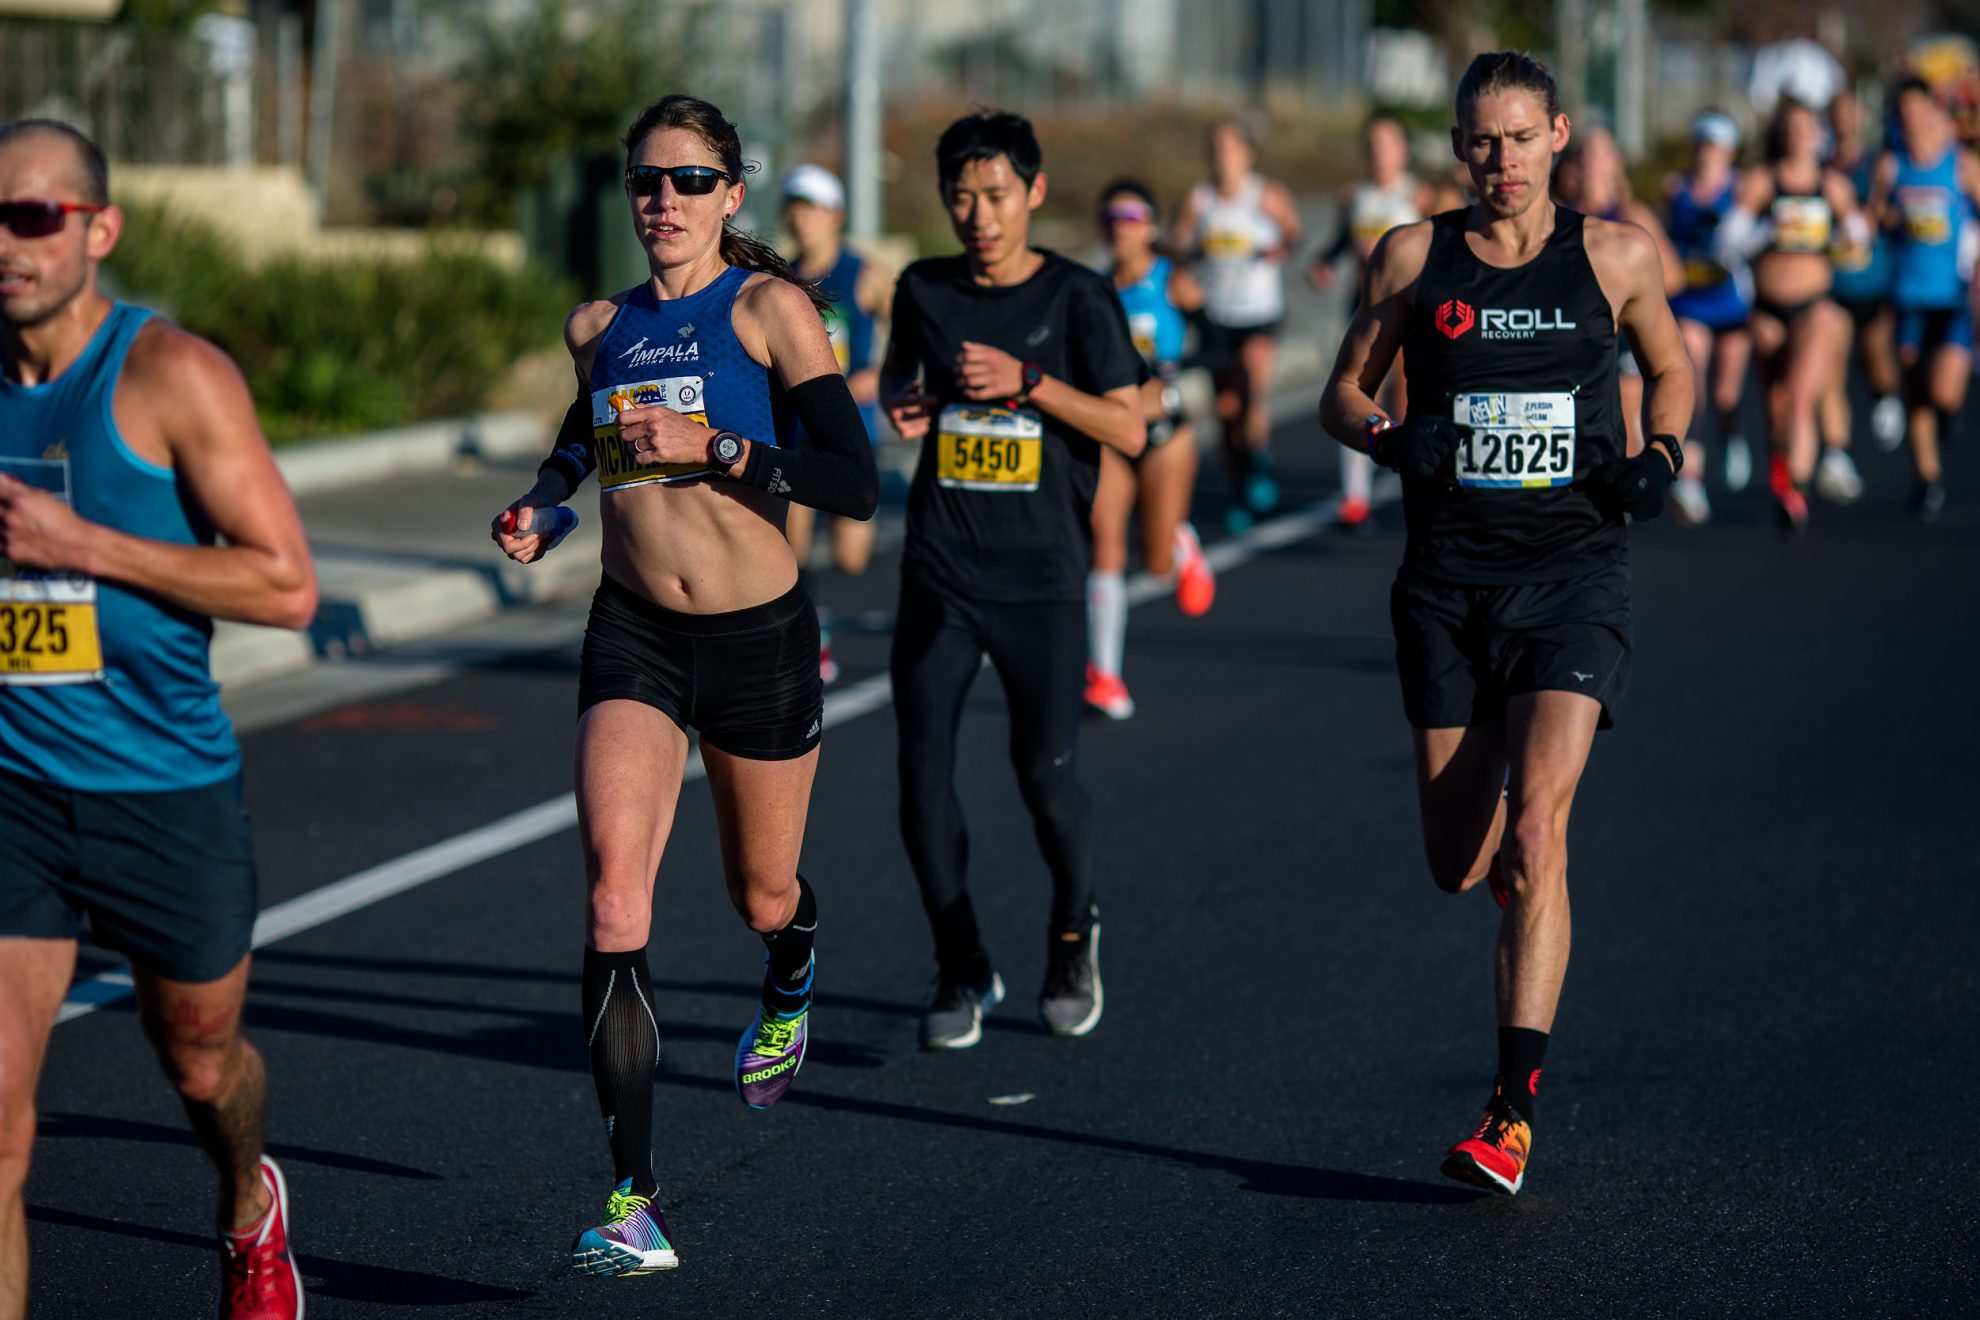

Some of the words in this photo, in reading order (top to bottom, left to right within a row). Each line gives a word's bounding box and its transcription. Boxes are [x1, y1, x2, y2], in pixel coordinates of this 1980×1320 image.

[1480, 308, 1577, 330] ROLL
[1481, 331, 1536, 339] RECOVERY
[628, 358, 664, 369] RACING
[670, 355, 699, 363] TEAM
[631, 341, 699, 363] IMPALA
[954, 438, 1020, 473] 5450
[1462, 433, 1570, 475] 12625
[0, 606, 68, 654] 325
[742, 1055, 797, 1084] BROOKS
